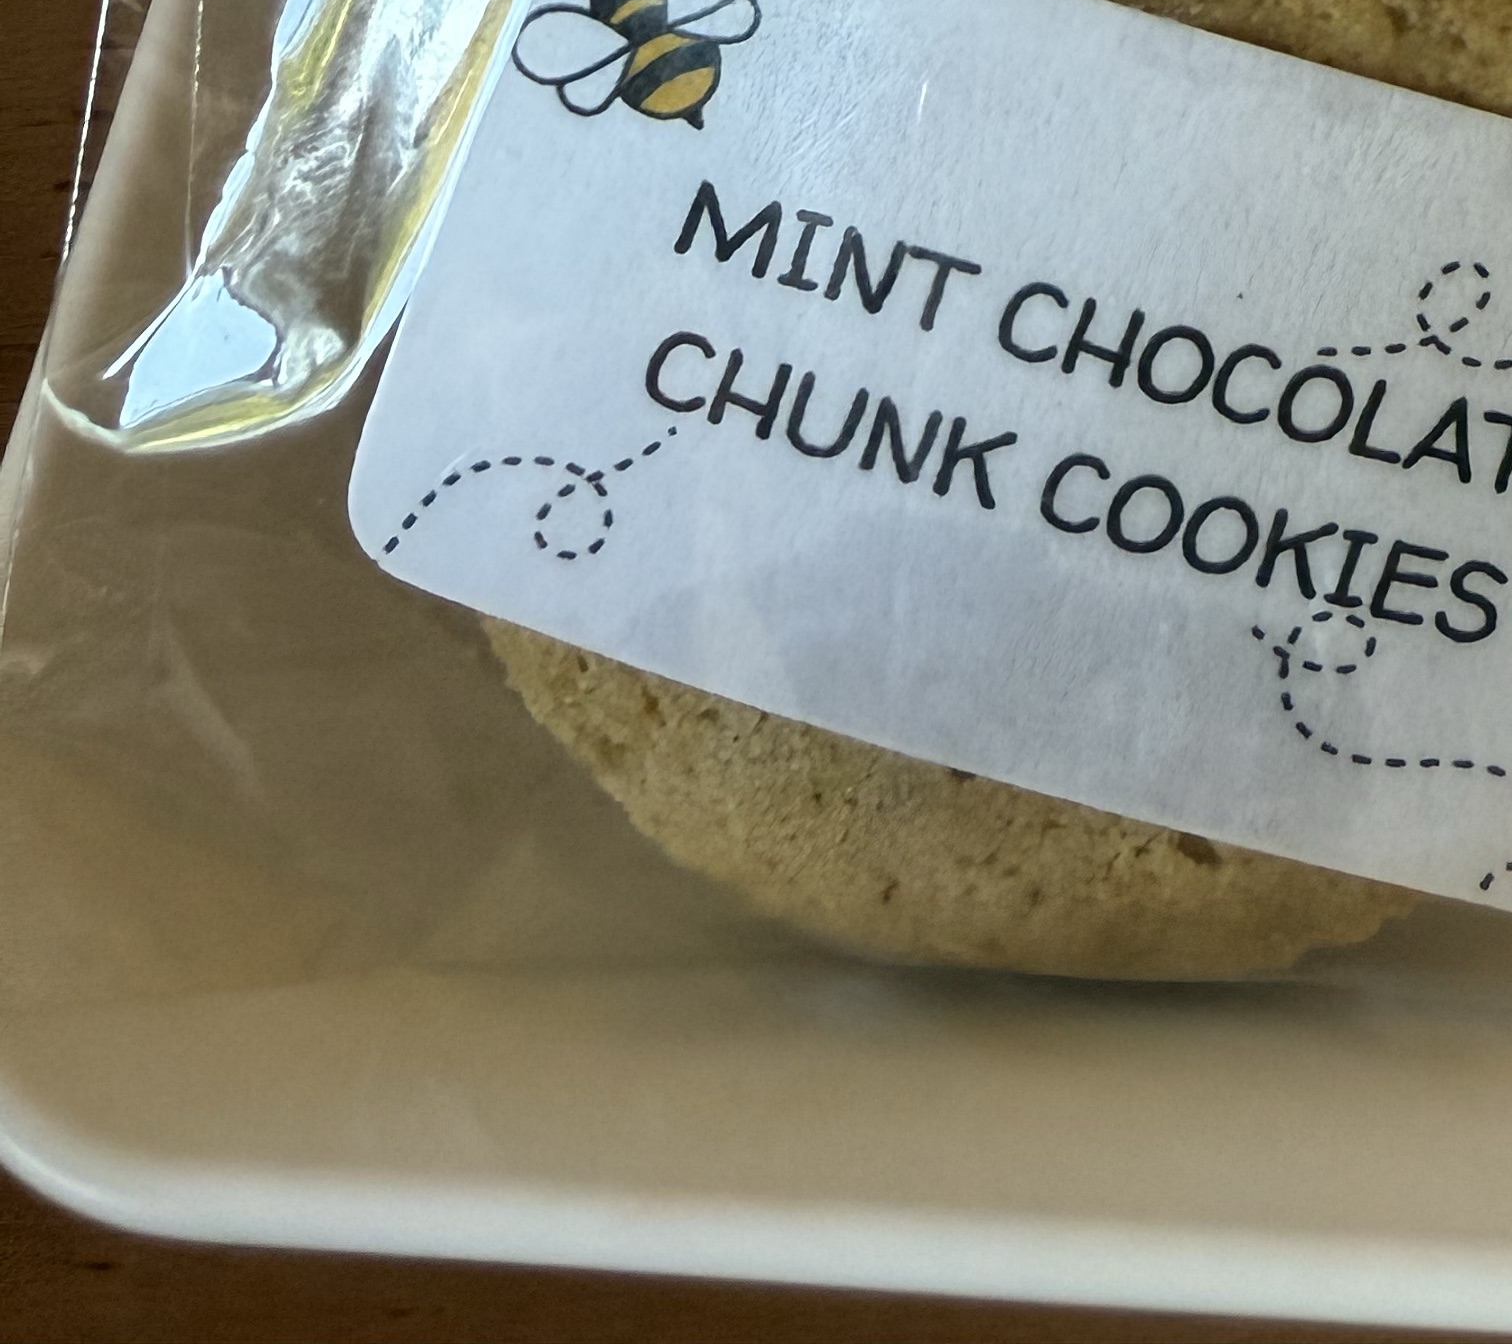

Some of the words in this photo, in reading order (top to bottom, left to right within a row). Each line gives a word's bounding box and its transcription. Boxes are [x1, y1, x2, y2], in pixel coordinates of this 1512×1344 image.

[674, 179, 981, 334] MINT
[643, 331, 1019, 512] CHUNK
[1038, 452, 1510, 645] COOKIES
